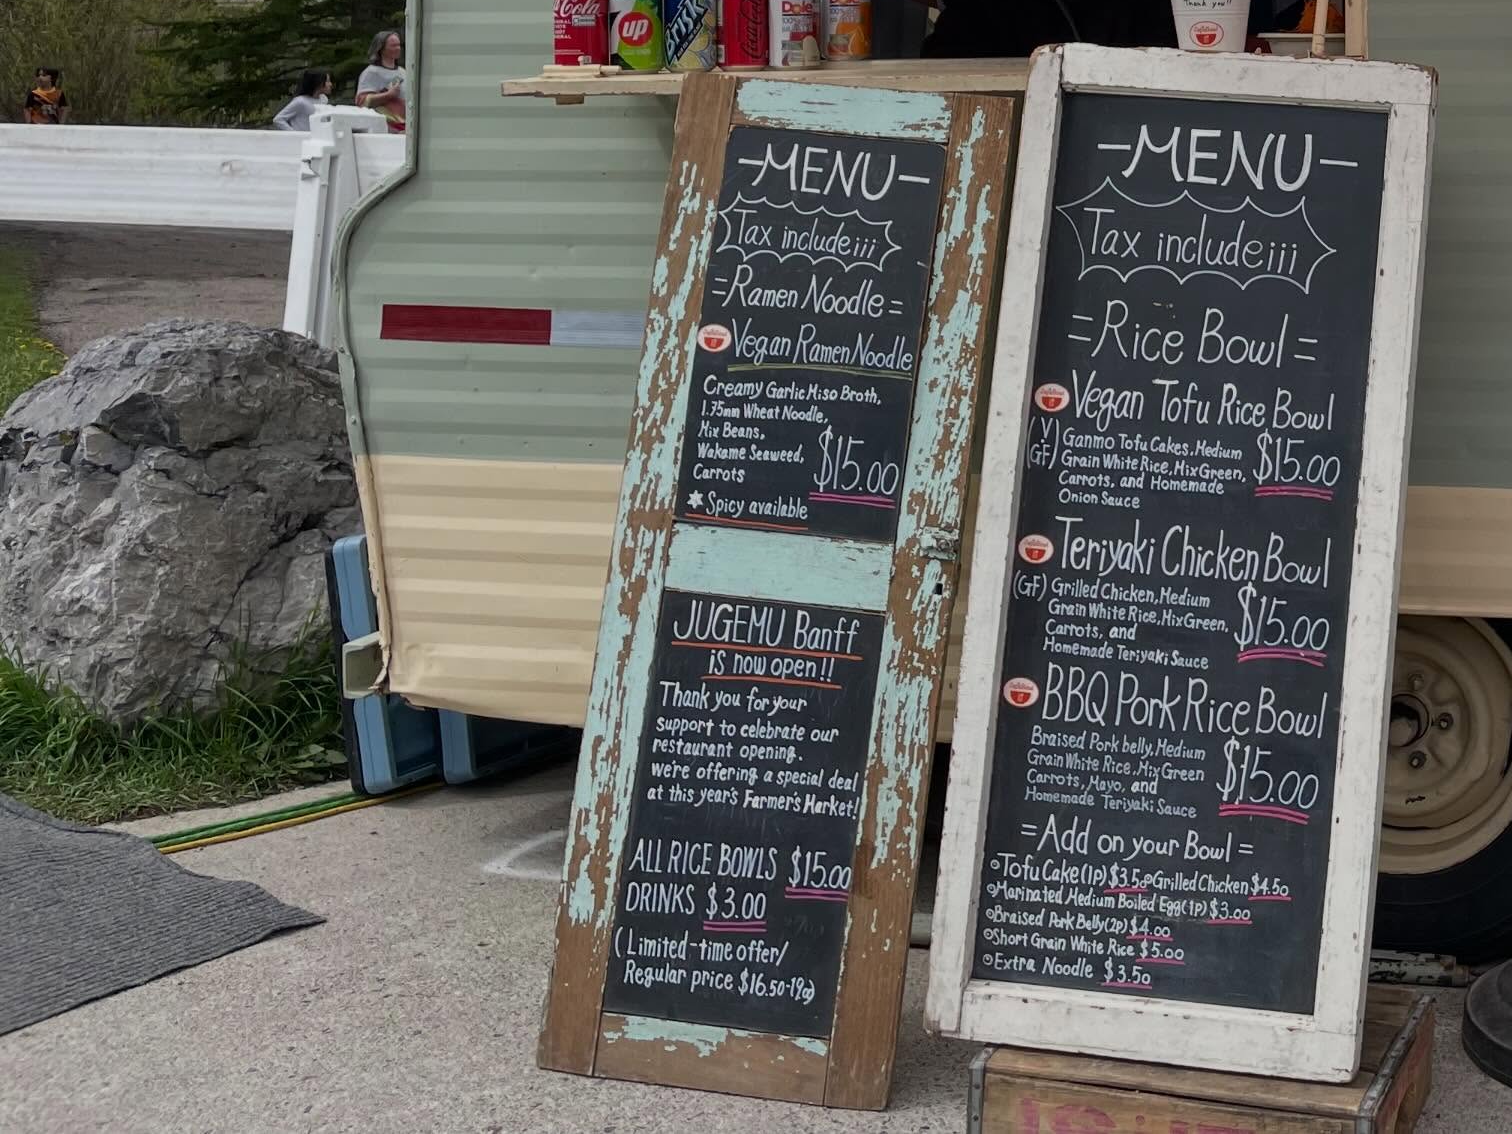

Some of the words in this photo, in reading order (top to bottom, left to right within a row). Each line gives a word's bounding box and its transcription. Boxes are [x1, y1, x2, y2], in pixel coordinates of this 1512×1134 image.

[734, 209, 771, 246] Tax
[1084, 208, 1141, 258] Tax
[732, 318, 791, 365] Vegan
[793, 323, 849, 364] Ramen
[850, 332, 913, 370] Noodle
[704, 375, 763, 399] Creamy
[765, 382, 804, 400] Garlic
[806, 383, 837, 401] Miso
[840, 384, 881, 405] Broth,
[1072, 369, 1143, 431] Vegan
[1153, 378, 1209, 424] Tofu
[1218, 383, 1265, 429] Rice
[1272, 387, 1334, 431] Bowl
[697, 420, 718, 439] Mix
[722, 421, 765, 440] Beans,
[744, 403, 779, 420] Wheat
[782, 405, 828, 424] Noodle,
[697, 443, 746, 460] Wakame
[749, 444, 804, 464] Seaweed,
[813, 425, 899, 495] $15.00
[1063, 427, 1113, 450] Ganmo
[1118, 433, 1147, 452] Tofu
[1196, 440, 1242, 460] Medium
[1253, 428, 1340, 487] $15.00
[693, 463, 745, 483] Carrots
[1058, 470, 1115, 489] Carrots,
[1120, 474, 1144, 489] and
[1151, 475, 1224, 495] Homemade
[1061, 450, 1099, 469] Grain
[1103, 454, 1138, 471] White
[1174, 459, 1198, 477] Mix
[1198, 465, 1246, 483] Green,
[706, 491, 744, 518] Spicy
[749, 495, 808, 520] available
[1058, 489, 1098, 506] Onion
[1101, 493, 1140, 508] Sauce
[1055, 516, 1155, 577] Teriyaki
[1161, 524, 1259, 581] Chicken
[1262, 531, 1330, 588] Bowl
[1013, 570, 1047, 601] (GF)
[1051, 577, 1100, 598] Grilled
[1101, 583, 1159, 605] Chicken,
[1159, 586, 1210, 608] Medium
[674, 599, 786, 647] JUGEMU
[793, 610, 860, 654] Banff
[1046, 619, 1103, 640] Carrots,
[1109, 623, 1136, 641] and
[1048, 600, 1086, 618] Grain
[1089, 602, 1125, 622] White
[1162, 609, 1183, 627] Mix
[1183, 615, 1228, 633] Green,
[1234, 581, 1330, 651] $15.00
[709, 649, 725, 676] is
[733, 654, 766, 677] now
[1043, 636, 1113, 660] Homemade
[1117, 643, 1168, 666] Teriyaki
[1171, 652, 1209, 670] Sauce
[660, 681, 709, 711] Thank
[711, 690, 740, 712] you
[747, 686, 769, 712] for
[767, 695, 806, 716] your
[1041, 661, 1109, 727] BBQ
[1115, 671, 1181, 732] Pork
[1183, 677, 1250, 736] Rice
[1256, 685, 1327, 739] Bowl
[656, 716, 714, 737] support
[719, 720, 736, 737] to
[740, 718, 804, 741] celebrate
[811, 727, 839, 743] our
[1031, 725, 1086, 750] Braised
[1089, 733, 1119, 752] Pork
[1153, 739, 1205, 761] Medium
[653, 737, 733, 758] restaurant
[739, 744, 802, 764] opening.
[1027, 749, 1063, 767] Grain
[1065, 750, 1099, 770] White
[1138, 759, 1160, 779] Mix
[1161, 765, 1205, 782] Green
[651, 760, 689, 779] we're
[696, 763, 758, 785] offering
[763, 771, 772, 784] a
[776, 769, 824, 788] special
[828, 769, 858, 792] deal
[1027, 768, 1086, 791] Carrots,
[1131, 778, 1158, 794] and
[1216, 736, 1318, 809] $15.00
[647, 784, 664, 800] at
[669, 783, 694, 803] this
[694, 787, 738, 807] year's
[743, 789, 801, 813] Farmer's
[803, 794, 860, 819] Market!
[1024, 785, 1095, 806] Homemade
[1100, 794, 1154, 814] Teriyaki
[1156, 800, 1198, 819] Sauce
[629, 838, 662, 874] ALL
[667, 840, 713, 876] RICE
[717, 842, 778, 881] BOWLS
[789, 846, 852, 889] $15.00
[1097, 833, 1124, 854] on
[1124, 835, 1179, 861] your
[997, 852, 1040, 881] Tofu
[1108, 861, 1148, 891] $3.50
[1153, 870, 1198, 891] Grilled
[1198, 873, 1249, 897] Chicken
[1250, 873, 1289, 897] $4.50
[625, 882, 695, 915] DRINKS
[993, 880, 1063, 906] Marinated
[1067, 888, 1115, 909] Medium
[1117, 892, 1155, 914] Boiled
[1209, 897, 1251, 922] $3.00
[994, 905, 1044, 926] Braised
[1049, 911, 1075, 930] Pork
[1129, 915, 1171, 938] $4.00
[992, 928, 1029, 947] Short
[1031, 931, 1066, 951] Grain
[1070, 934, 1104, 954] White
[1108, 939, 1135, 957] Rice
[1140, 938, 1184, 961] $5.00
[624, 959, 686, 988] Regular
[691, 969, 733, 992] price
[994, 952, 1036, 972] Extra
[1042, 957, 1094, 979] Noodle
[1103, 956, 1151, 985] $3.50
